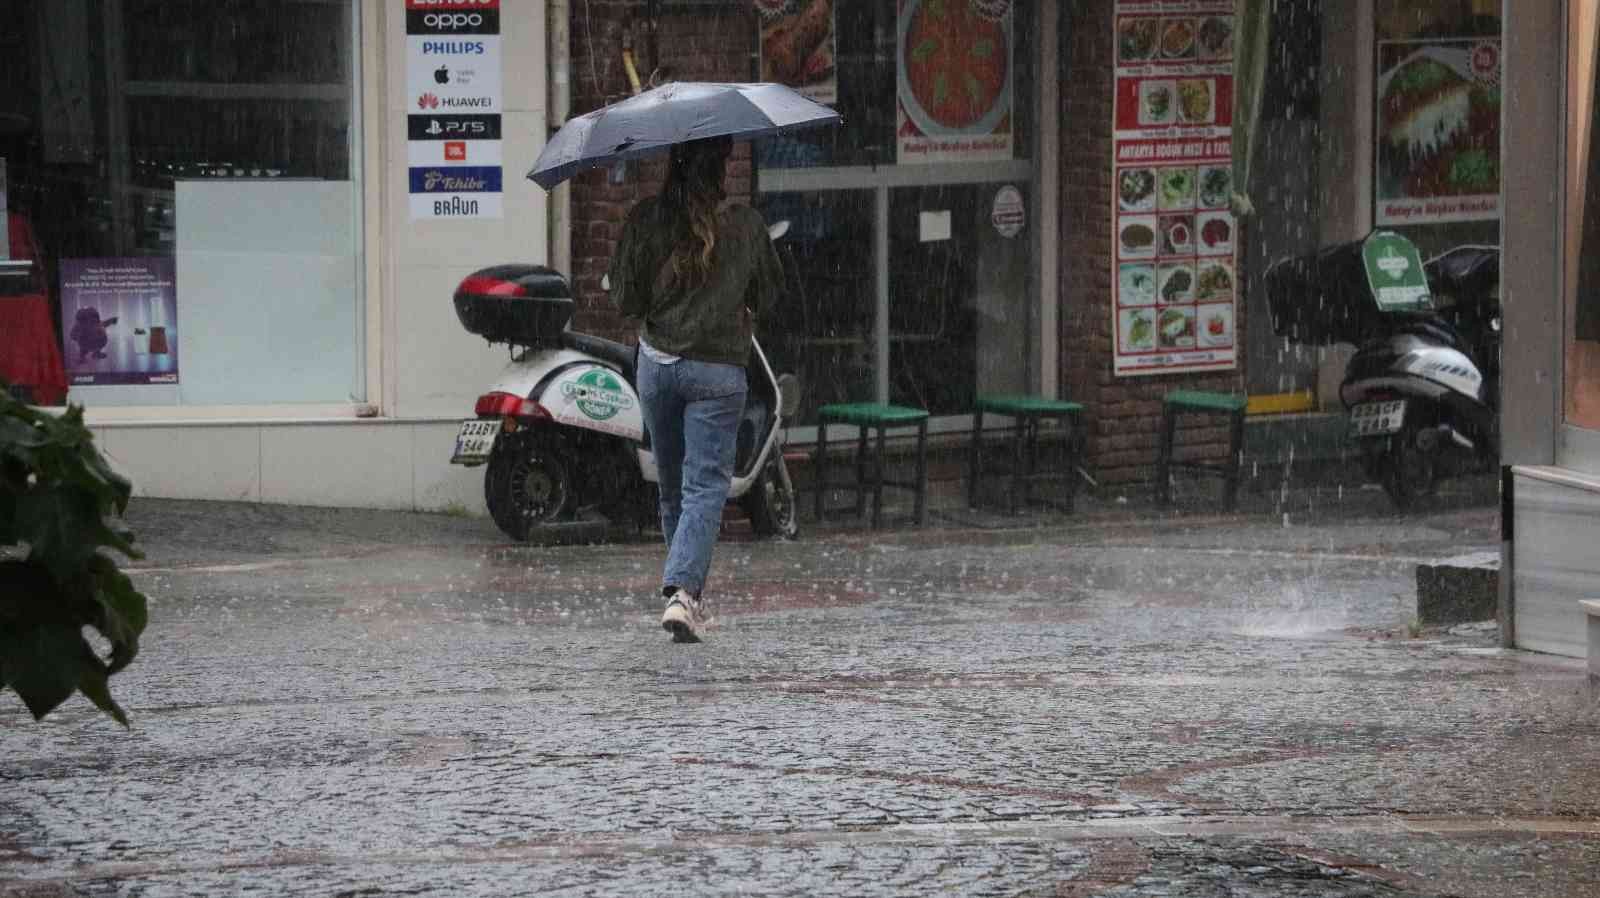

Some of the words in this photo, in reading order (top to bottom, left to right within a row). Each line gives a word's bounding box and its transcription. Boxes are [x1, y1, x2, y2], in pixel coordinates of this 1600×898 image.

[424, 14, 482, 29] oppo
[423, 42, 484, 54] PHILIPS
[442, 97, 492, 108] HUAWEI
[446, 121, 485, 132] PS5
[1119, 144, 1154, 158] ANTAKYA
[434, 196, 478, 215] BRAUN
